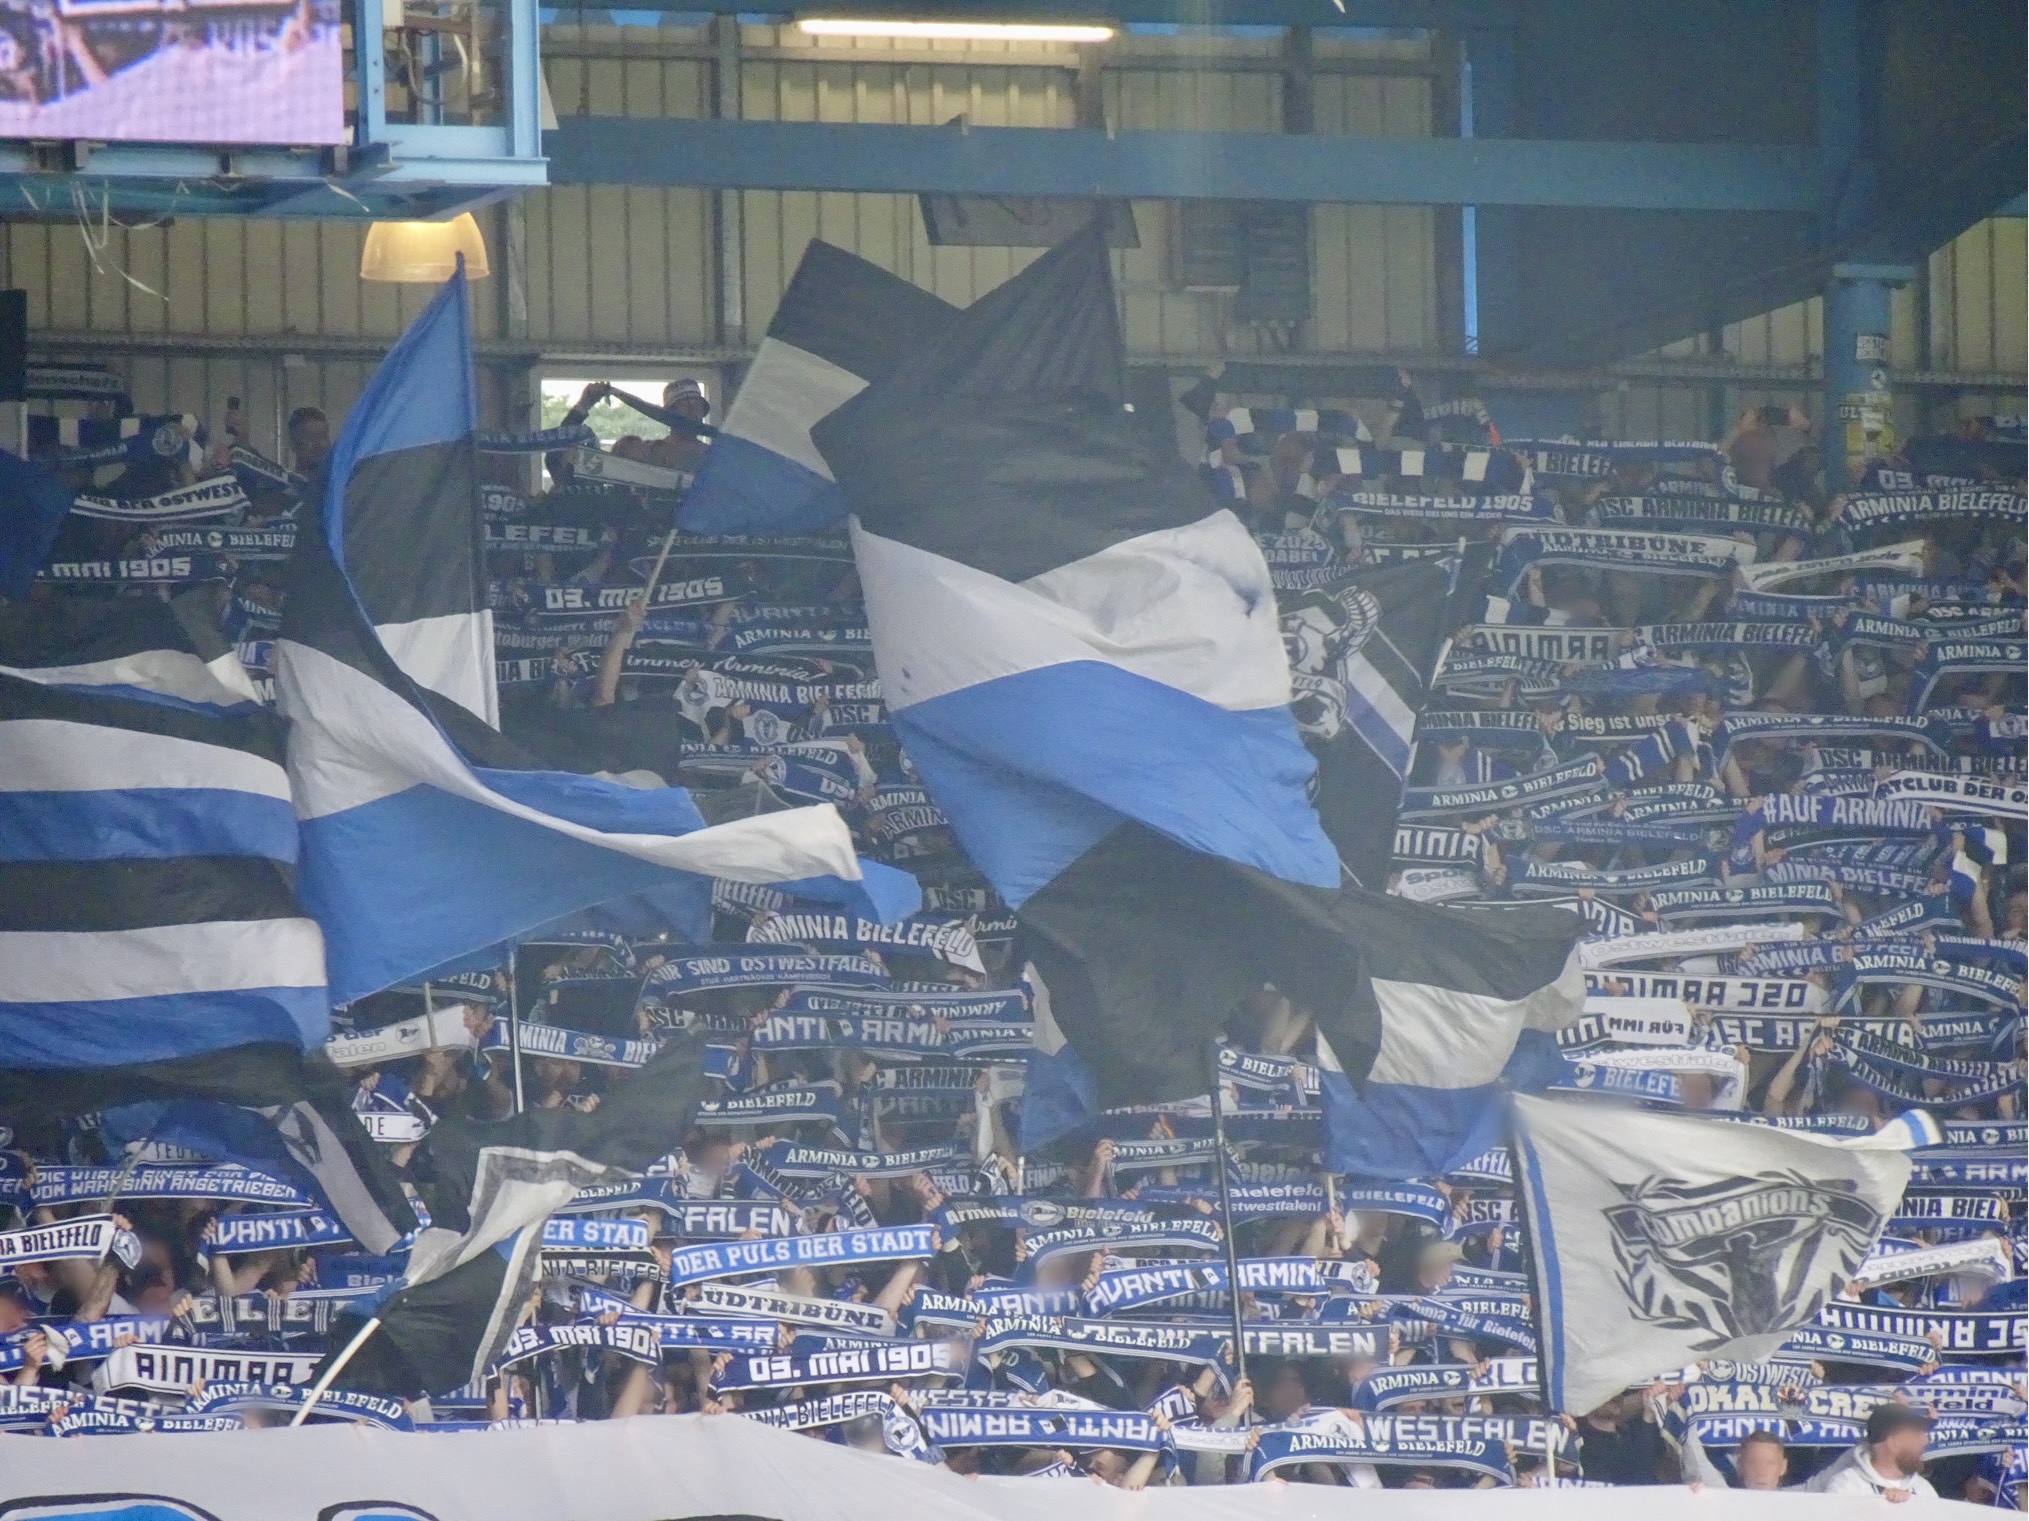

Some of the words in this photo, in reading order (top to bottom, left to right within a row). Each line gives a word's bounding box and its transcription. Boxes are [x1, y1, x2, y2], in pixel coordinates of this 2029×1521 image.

[1541, 532, 1707, 554] DTRIBÜNE
[120, 557, 191, 577] 1905
[1855, 618, 1921, 638] ARMINIA
[1938, 645, 2001, 662] ARMINIA
[1568, 713, 1605, 734] Sieg
[1610, 714, 1630, 730] ist
[1431, 789, 1499, 807] ARMINIA
[1523, 762, 1597, 793] BIELEFELD
[1964, 782, 2006, 801] DER
[1623, 801, 1698, 823] ARMINIA
[1763, 794, 1823, 824] #AUF
[1832, 798, 1931, 830] ARMINIA
[1652, 888, 1721, 911] ARMINIA
[687, 958, 730, 975] SIND
[1853, 954, 1926, 971] ARMINIA
[499, 1021, 567, 1053] AMINIA
[786, 1149, 858, 1166] ARMINIA
[30, 1184, 65, 1199] VOM
[71, 1177, 164, 1194] WAHSINN
[170, 1177, 297, 1198] ANGETRIEBEN
[1352, 1189, 1445, 1210] BIELEFELD
[684, 1206, 791, 1236] FALEN
[946, 1207, 1019, 1224] Arminia
[1066, 1206, 1156, 1224] Bielefeld
[1637, 1188, 1831, 1244] Companions
[22, 1224, 101, 1252] BIELEFELD
[675, 1253, 721, 1277] DER
[728, 1240, 791, 1264] PULS
[798, 1235, 844, 1259] DER
[852, 1231, 930, 1253] STADT
[921, 1293, 998, 1316] ARMINIA
[550, 1325, 600, 1345] MAI
[985, 1319, 1061, 1340] ARMINIA
[1851, 1338, 1936, 1363] BIELEFELD
[749, 1356, 800, 1382] 03.
[809, 1350, 870, 1376] MAI
[301, 1388, 403, 1419] BELEFELD
[1916, 1386, 2009, 1399] rmini
[797, 1392, 896, 1426] BIELEFELD
[51, 1412, 129, 1438] ARMINIA
[1366, 1415, 1568, 1455] WESTFALEN
[1290, 1435, 1367, 1452] ARMINIA
